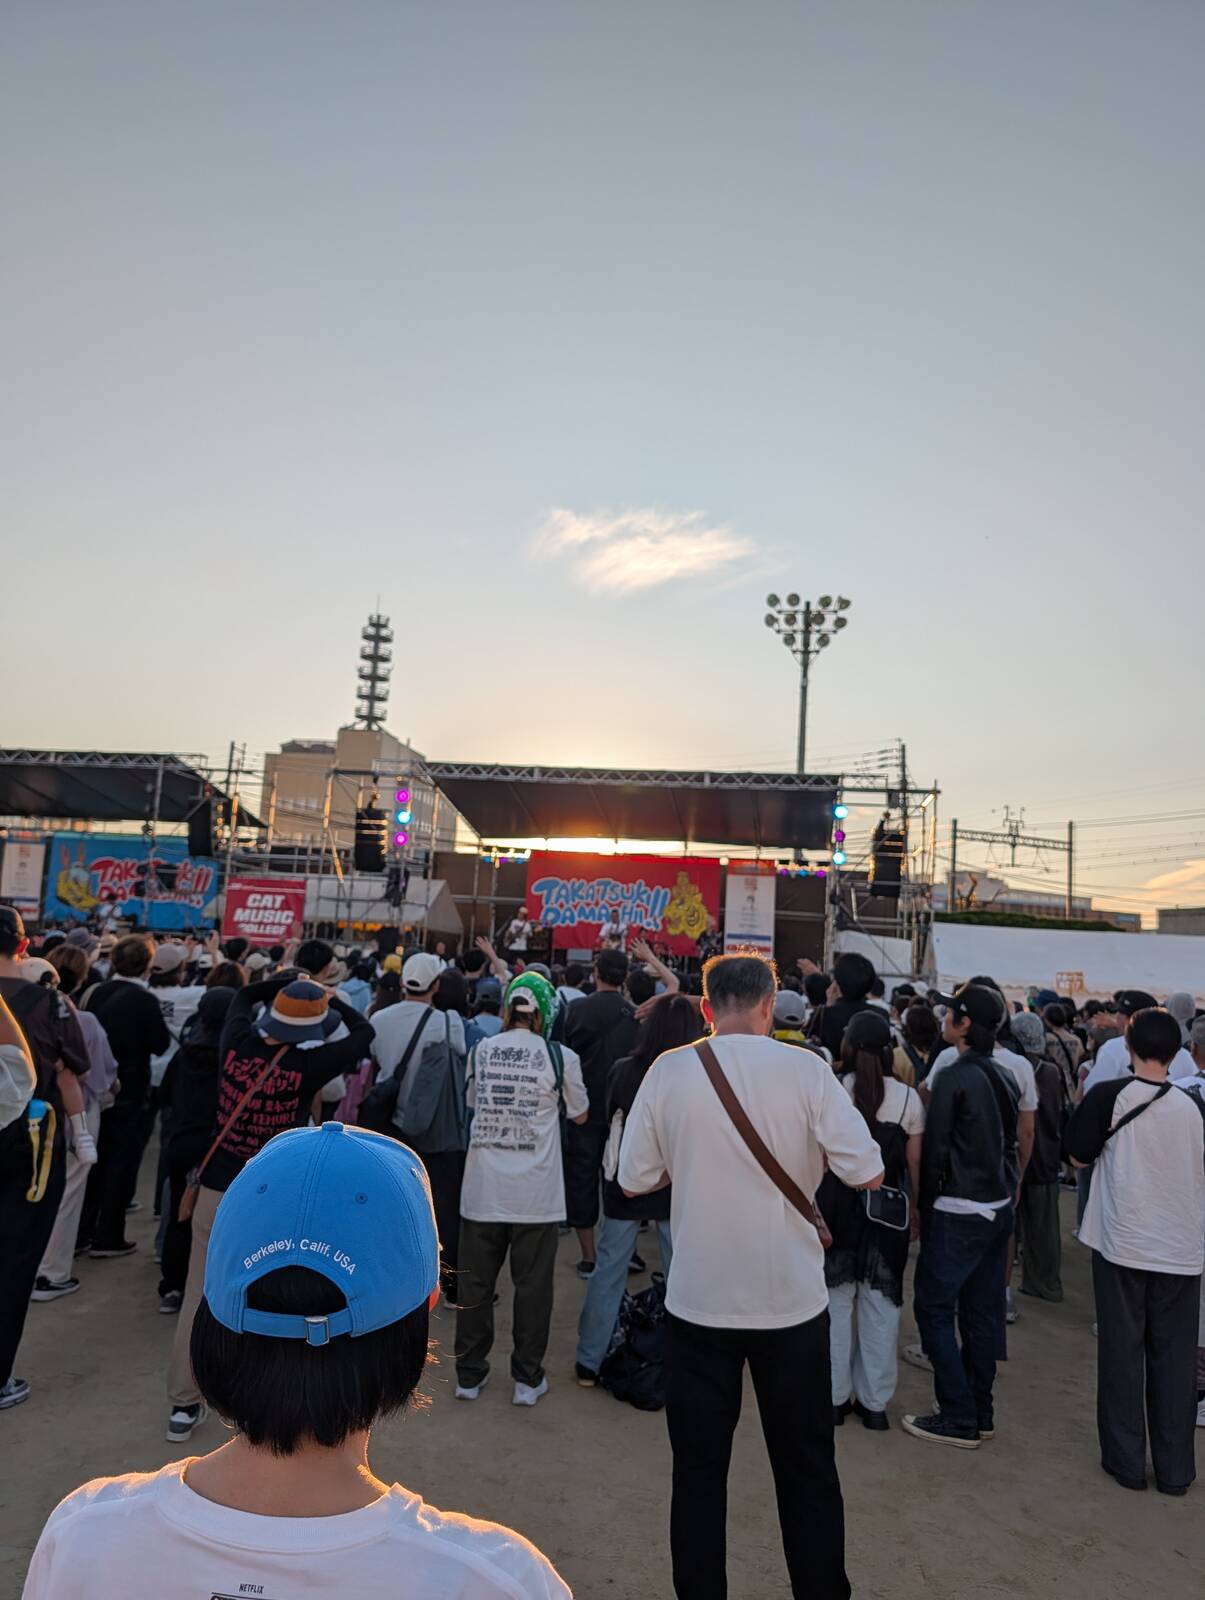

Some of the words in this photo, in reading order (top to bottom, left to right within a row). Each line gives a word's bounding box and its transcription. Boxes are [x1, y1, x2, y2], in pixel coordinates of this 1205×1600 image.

[247, 893, 286, 909] CAT
[233, 907, 295, 924] MUSIC
[243, 1238, 295, 1270] Berkeley,
[333, 1249, 357, 1276] USA
[239, 1583, 264, 1594] NETFLIX
